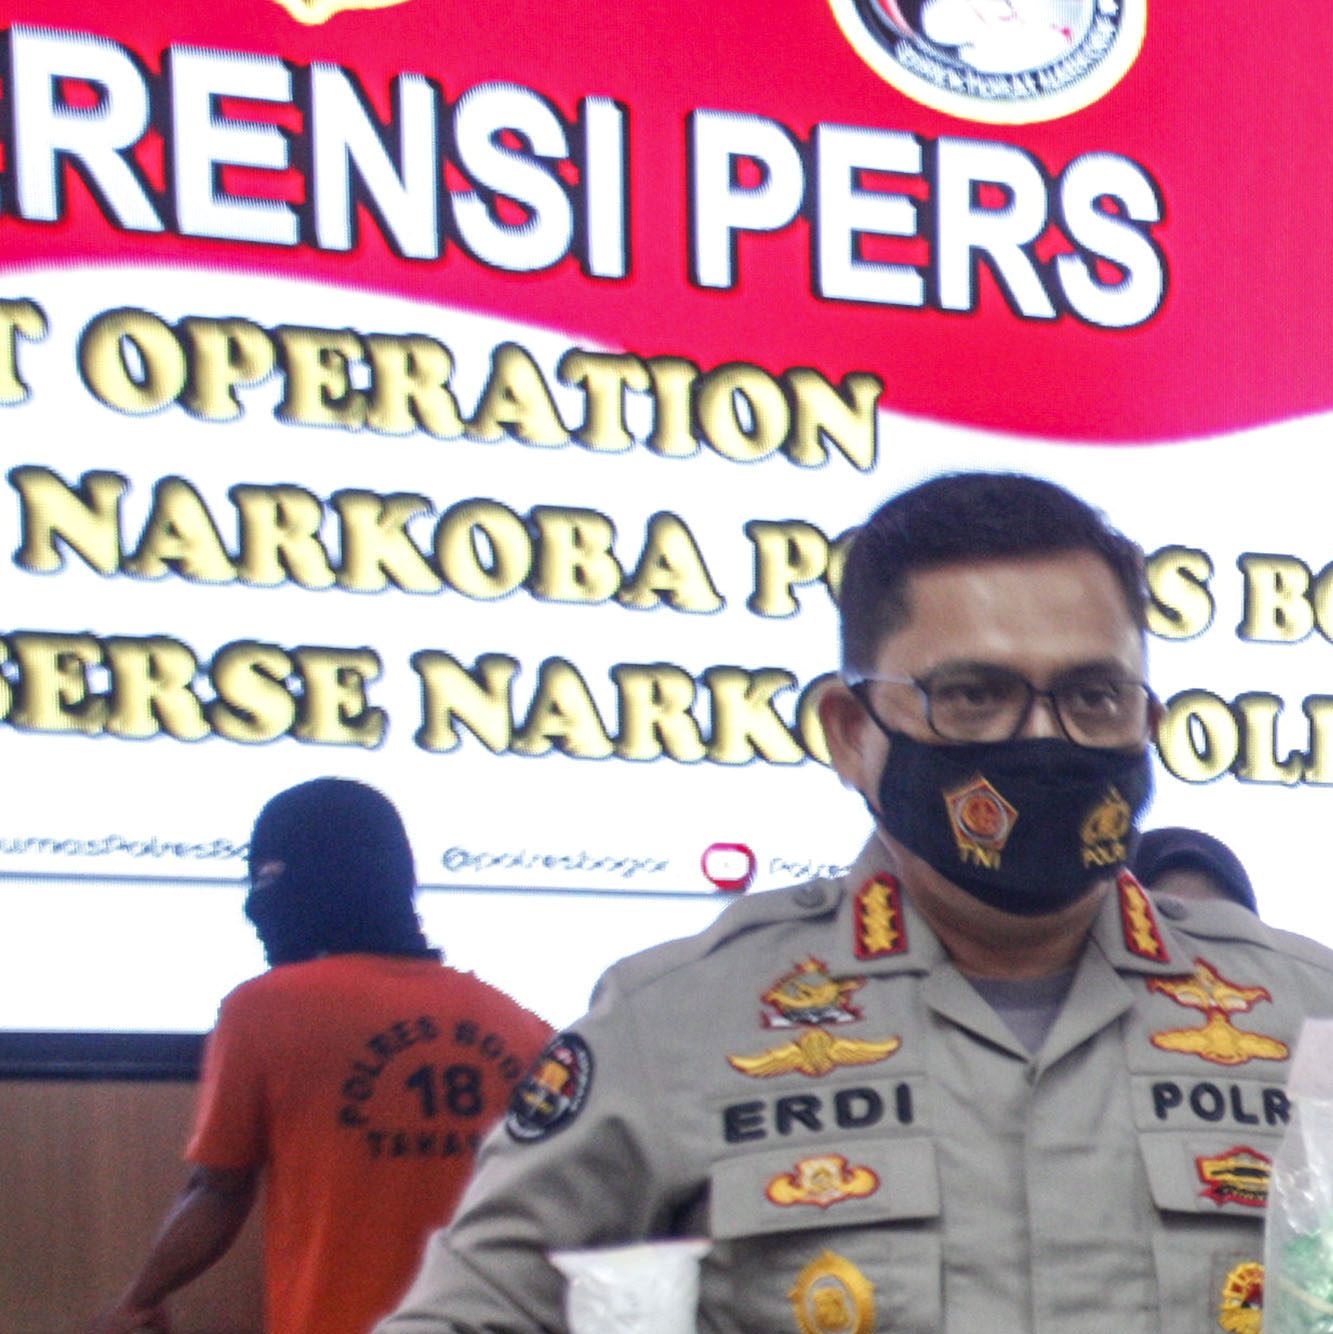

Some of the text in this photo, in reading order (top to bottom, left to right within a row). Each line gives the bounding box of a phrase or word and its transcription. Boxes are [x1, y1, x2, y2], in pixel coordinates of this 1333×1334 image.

[12, 24, 627, 278] RENSI
[692, 107, 1166, 330] PERS
[77, 305, 886, 471] OPERATION
[8, 464, 726, 615] NARKOBA
[0, 629, 388, 750] ERSE
[407, 1063, 483, 1119] 18
[722, 1082, 915, 1144] ERDI
[1152, 1081, 1292, 1127] POLR
